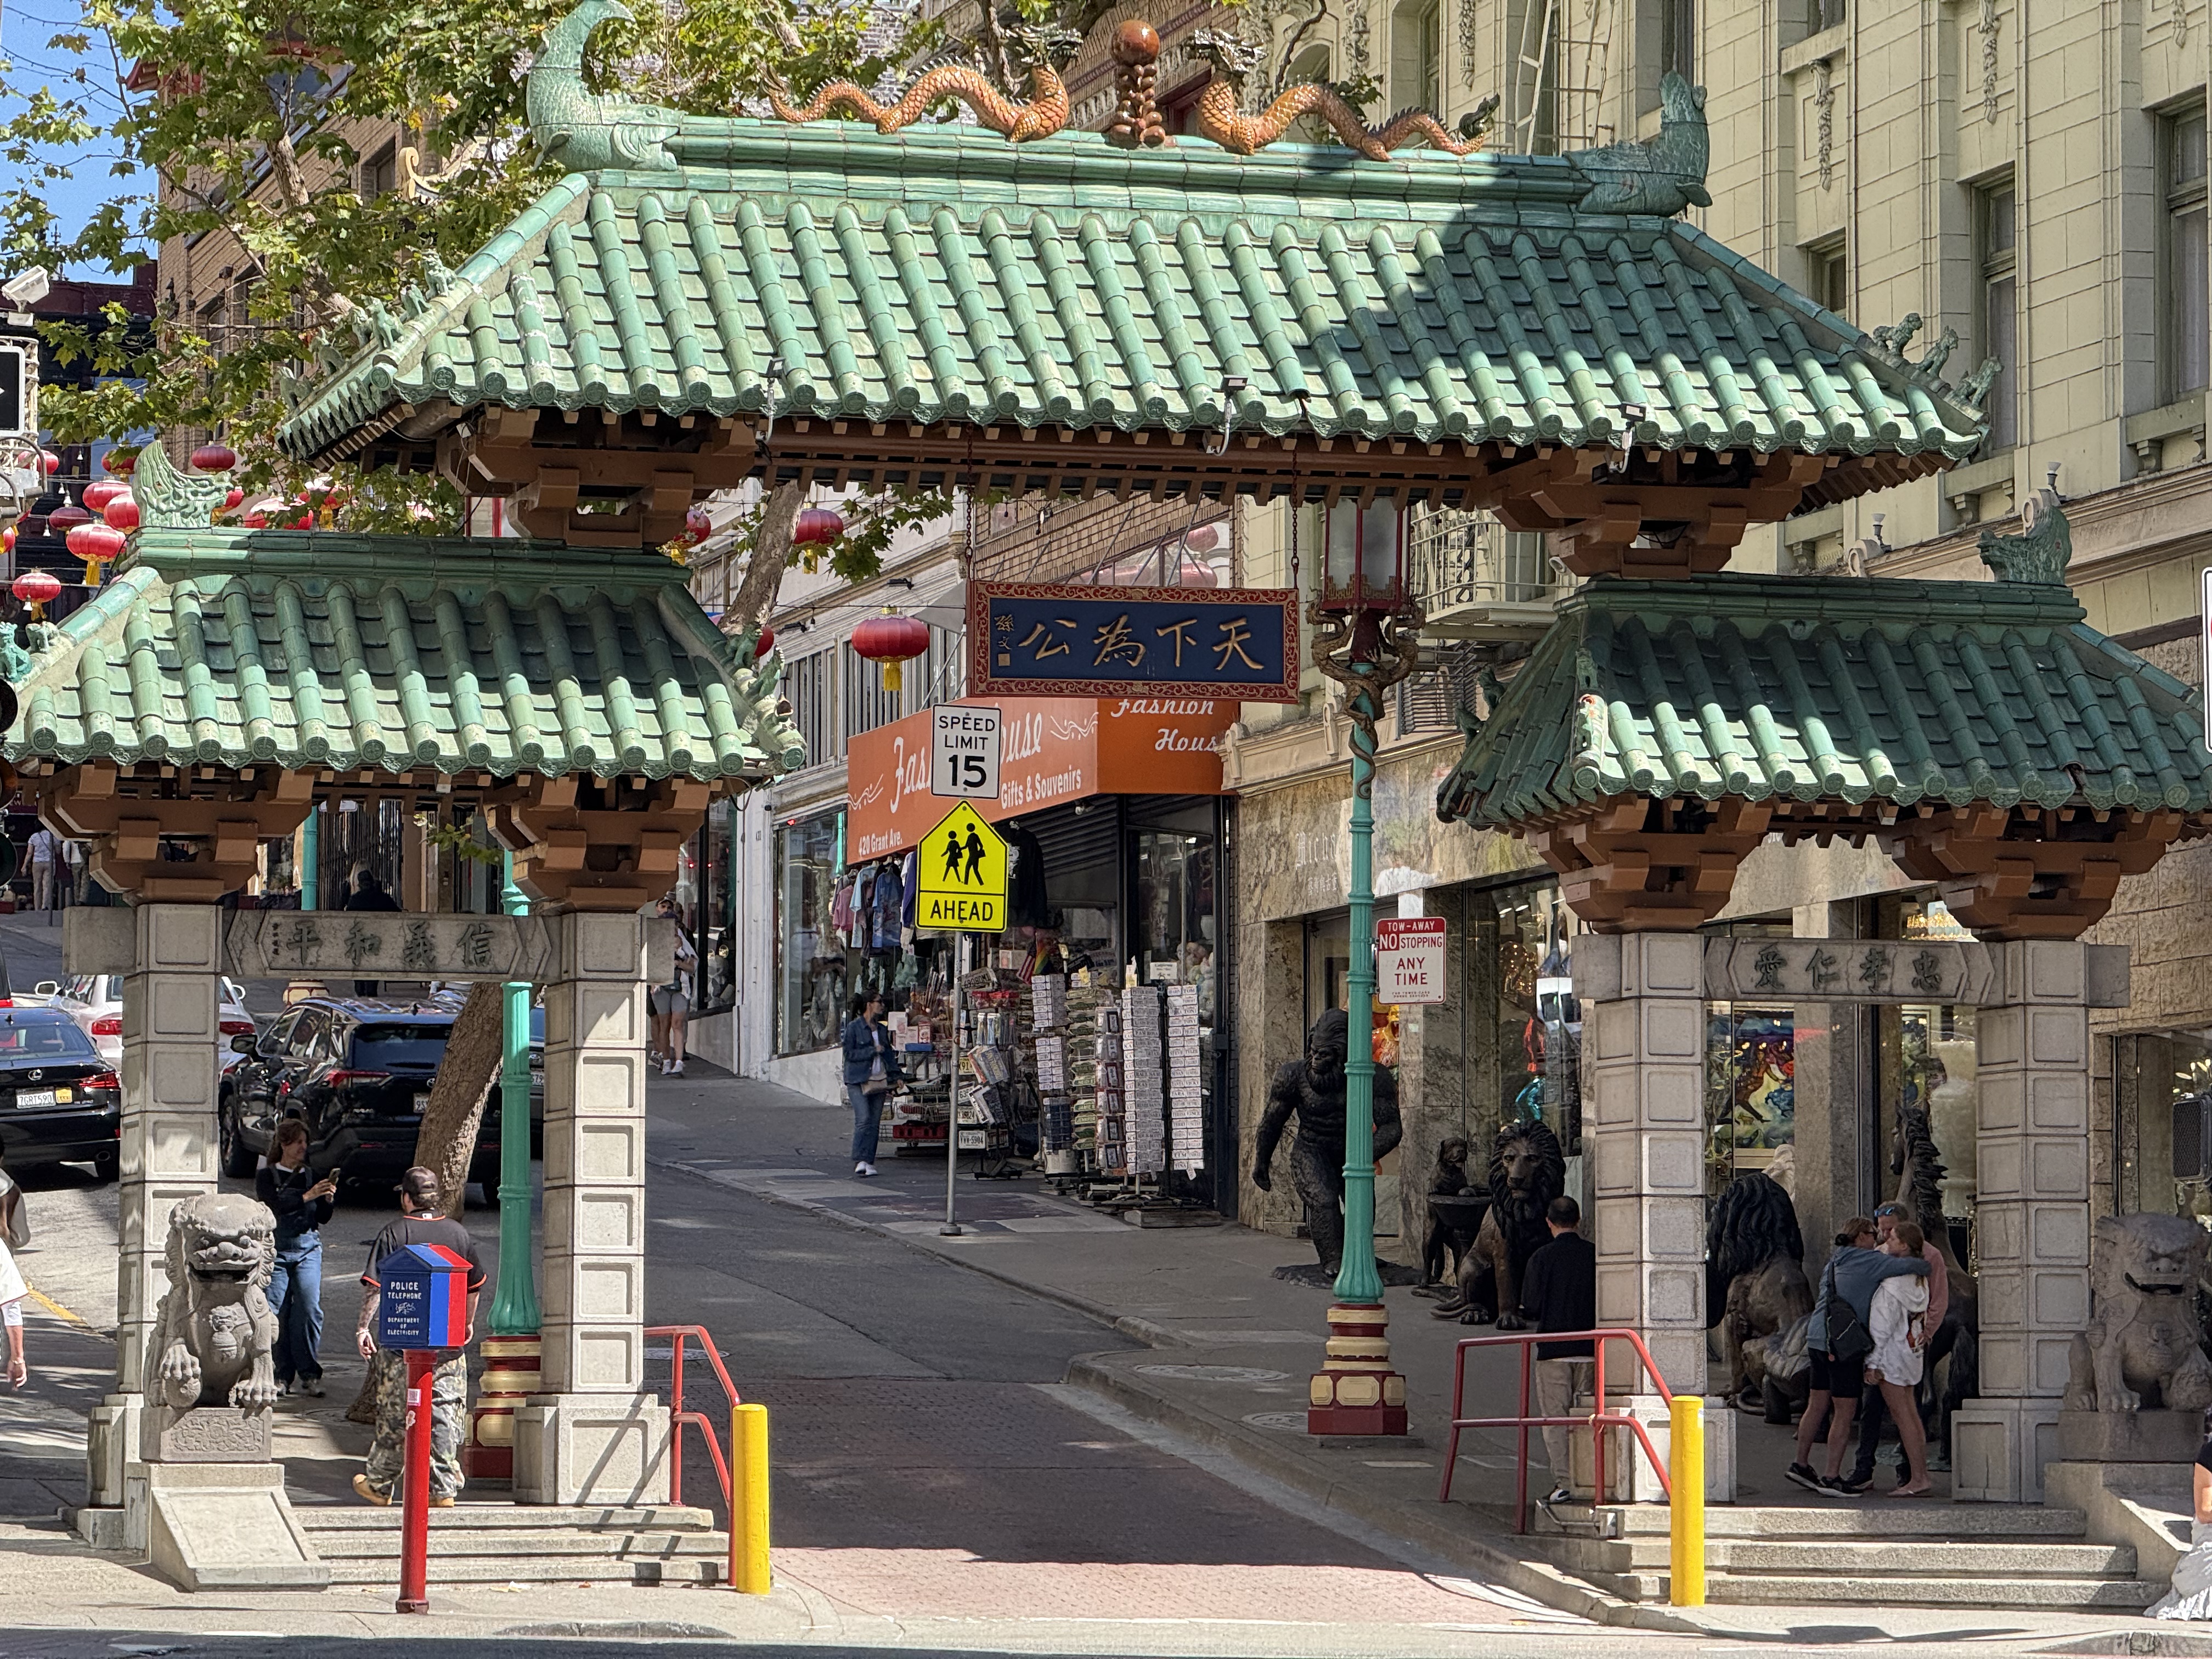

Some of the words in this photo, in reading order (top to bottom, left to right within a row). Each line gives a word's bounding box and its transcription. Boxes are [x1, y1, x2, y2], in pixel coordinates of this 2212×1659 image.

[939, 715, 996, 732] SPEED
[944, 735, 989, 751] LIMIT
[1155, 728, 1217, 752] Hous
[948, 754, 987, 788] 15
[1001, 782, 1024, 810] Gifts
[1025, 775, 1033, 802] &
[1035, 764, 1082, 800] Souvenirs
[858, 834, 870, 857] 420
[871, 830, 888, 853] Grant
[889, 828, 903, 848] Ave.
[930, 899, 994, 922] AHEAD
[1387, 921, 1435, 932] TOW-AWAY
[1379, 933, 1398, 950] NO
[1401, 936, 1443, 949] STOPPING
[1396, 957, 1426, 970] ANY
[1394, 972, 1428, 986] TIME
[391, 1282, 419, 1291] POLICE
[387, 1291, 422, 1300] TELEPHONE
